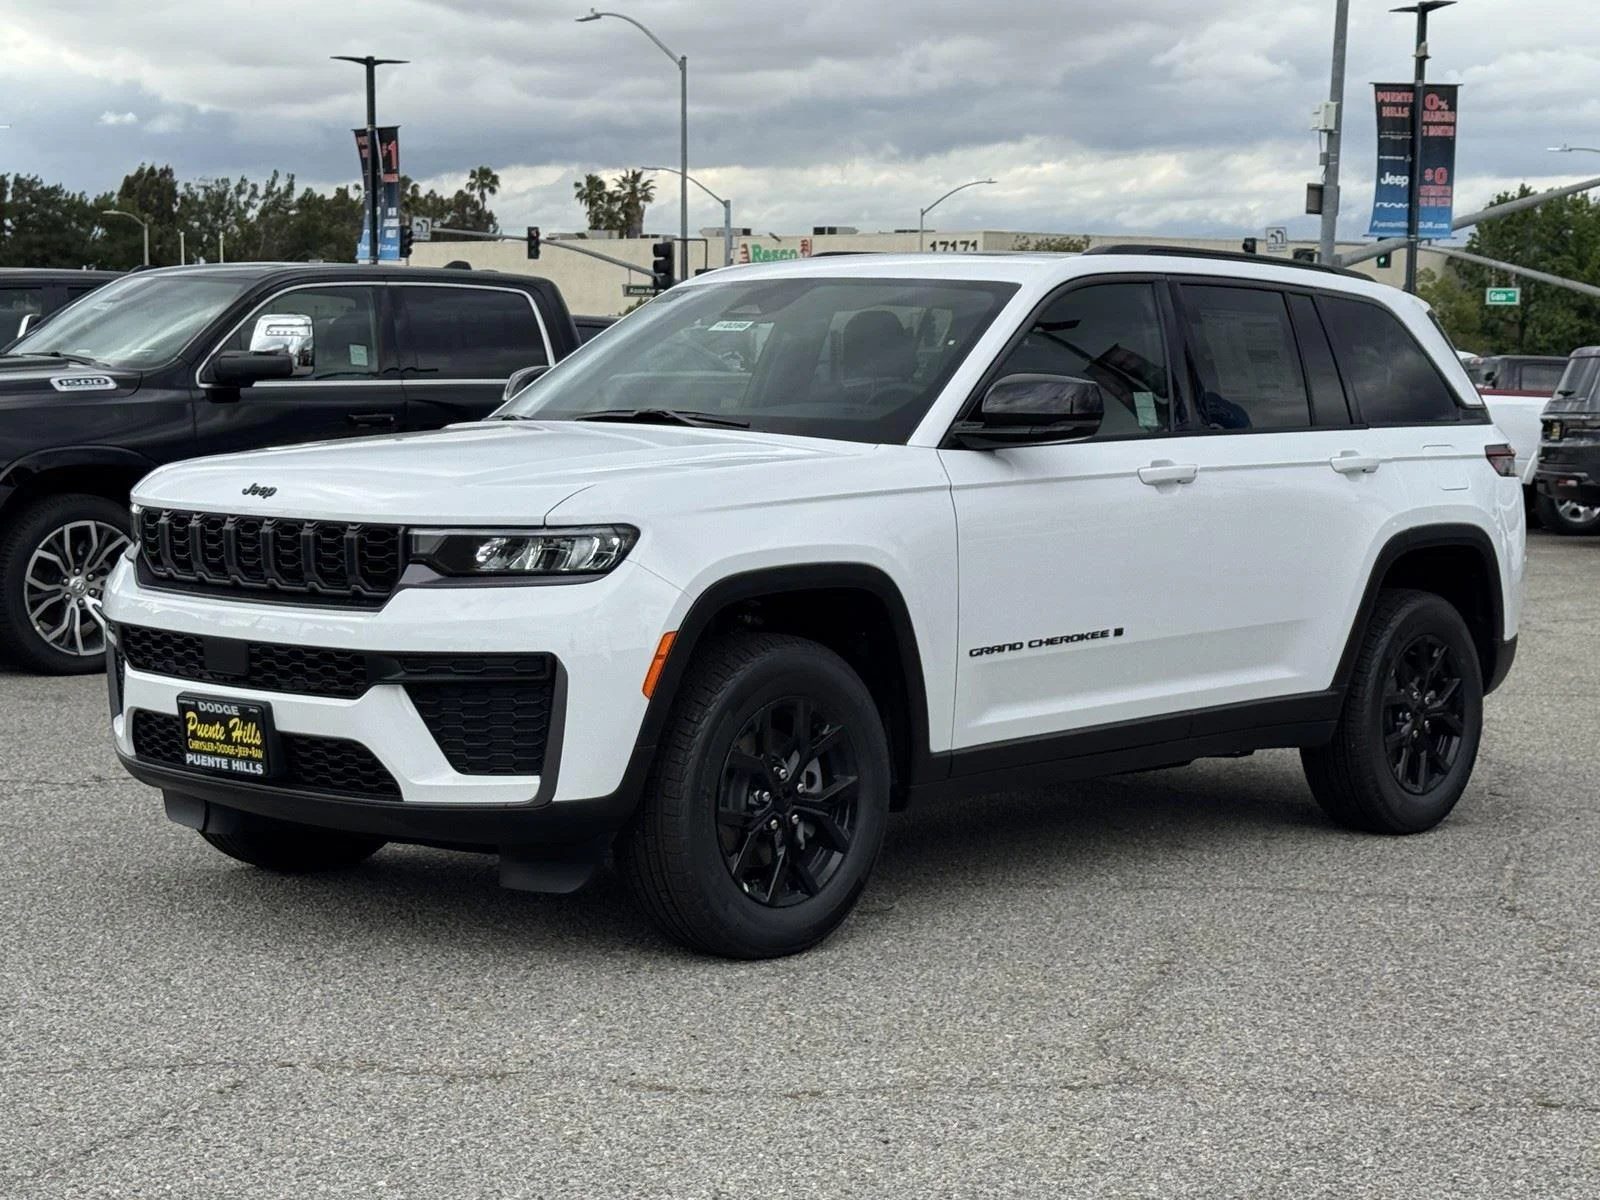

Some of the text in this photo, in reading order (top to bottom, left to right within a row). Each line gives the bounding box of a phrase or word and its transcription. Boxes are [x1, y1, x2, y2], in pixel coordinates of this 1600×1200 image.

[1382, 107, 1409, 117] HILLS
[1380, 171, 1409, 187] Jeep
[930, 240, 978, 251] 17171
[242, 483, 277, 499] Jeep
[969, 629, 1110, 657] GRAND CHEROKEE
[198, 701, 240, 716] DODGE
[185, 711, 262, 745] Puente Hills
[185, 753, 264, 775] PUENTE HILLS
